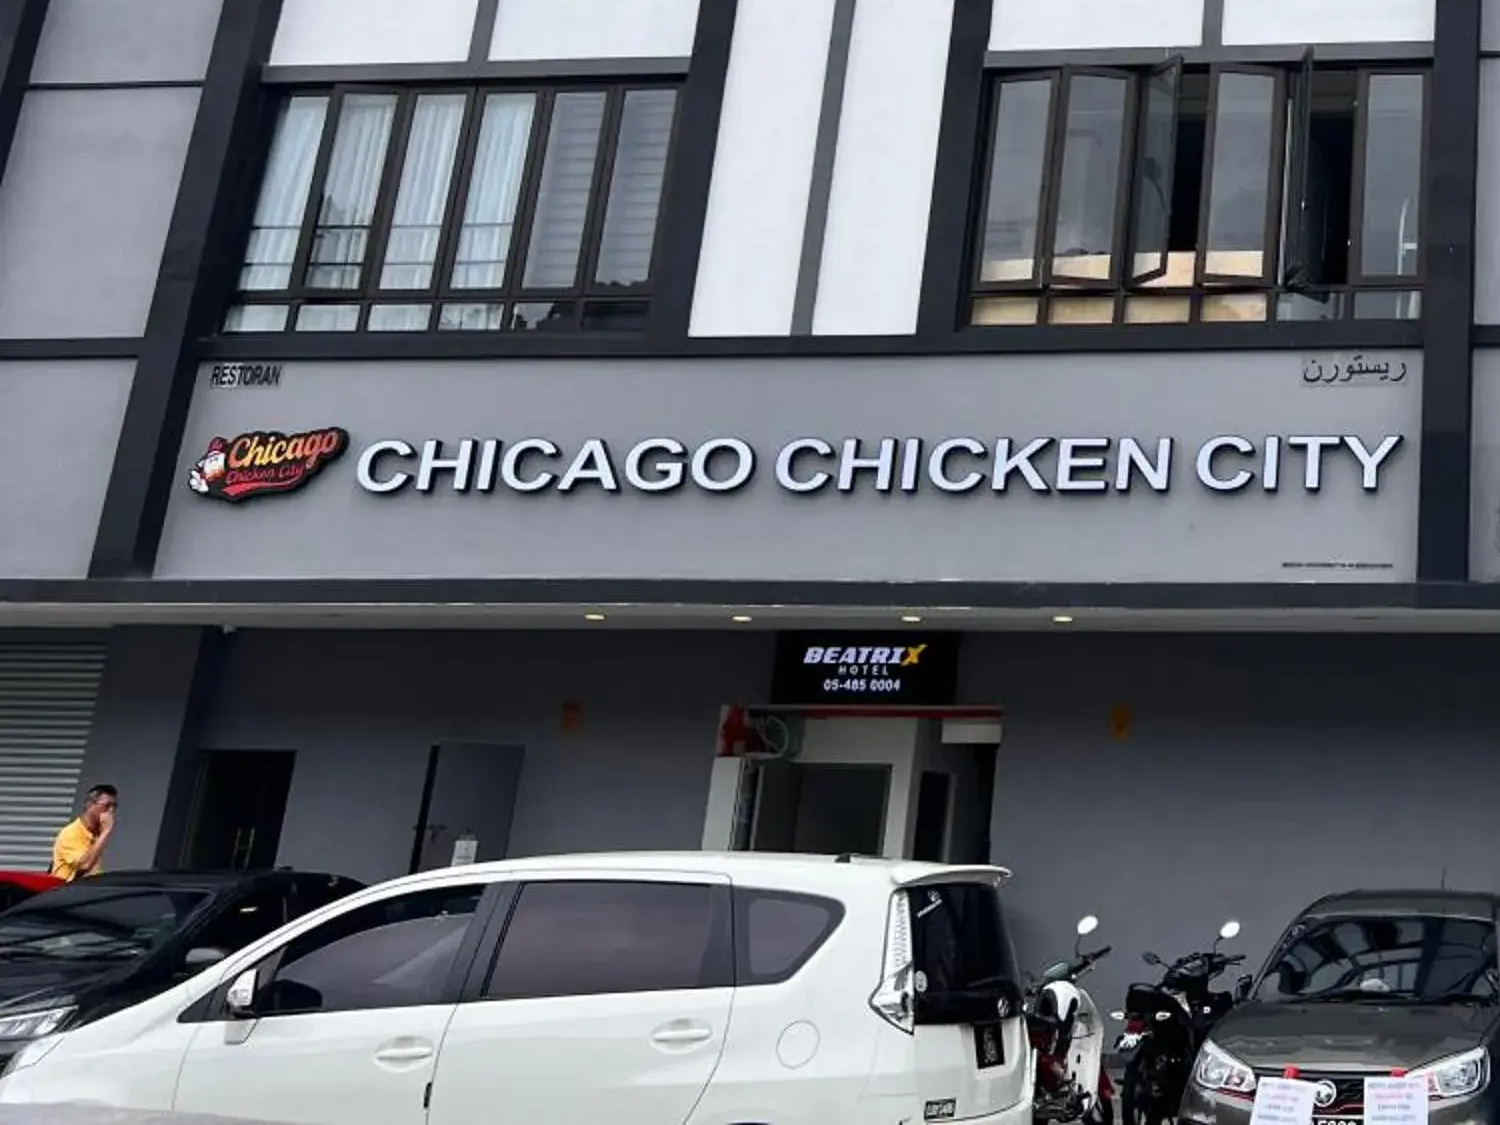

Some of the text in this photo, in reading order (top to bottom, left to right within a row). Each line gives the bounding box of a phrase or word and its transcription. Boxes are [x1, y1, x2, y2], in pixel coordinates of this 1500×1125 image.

[211, 364, 282, 386] RESTORAN
[1303, 354, 1407, 383] ريستورن
[227, 431, 340, 469] Chicago
[357, 434, 1404, 493] CHICAGO CHICKEN CITY
[804, 644, 928, 666] BEATRIX
[838, 665, 889, 675] HOTEL
[824, 679, 900, 692] 05-485 0004
